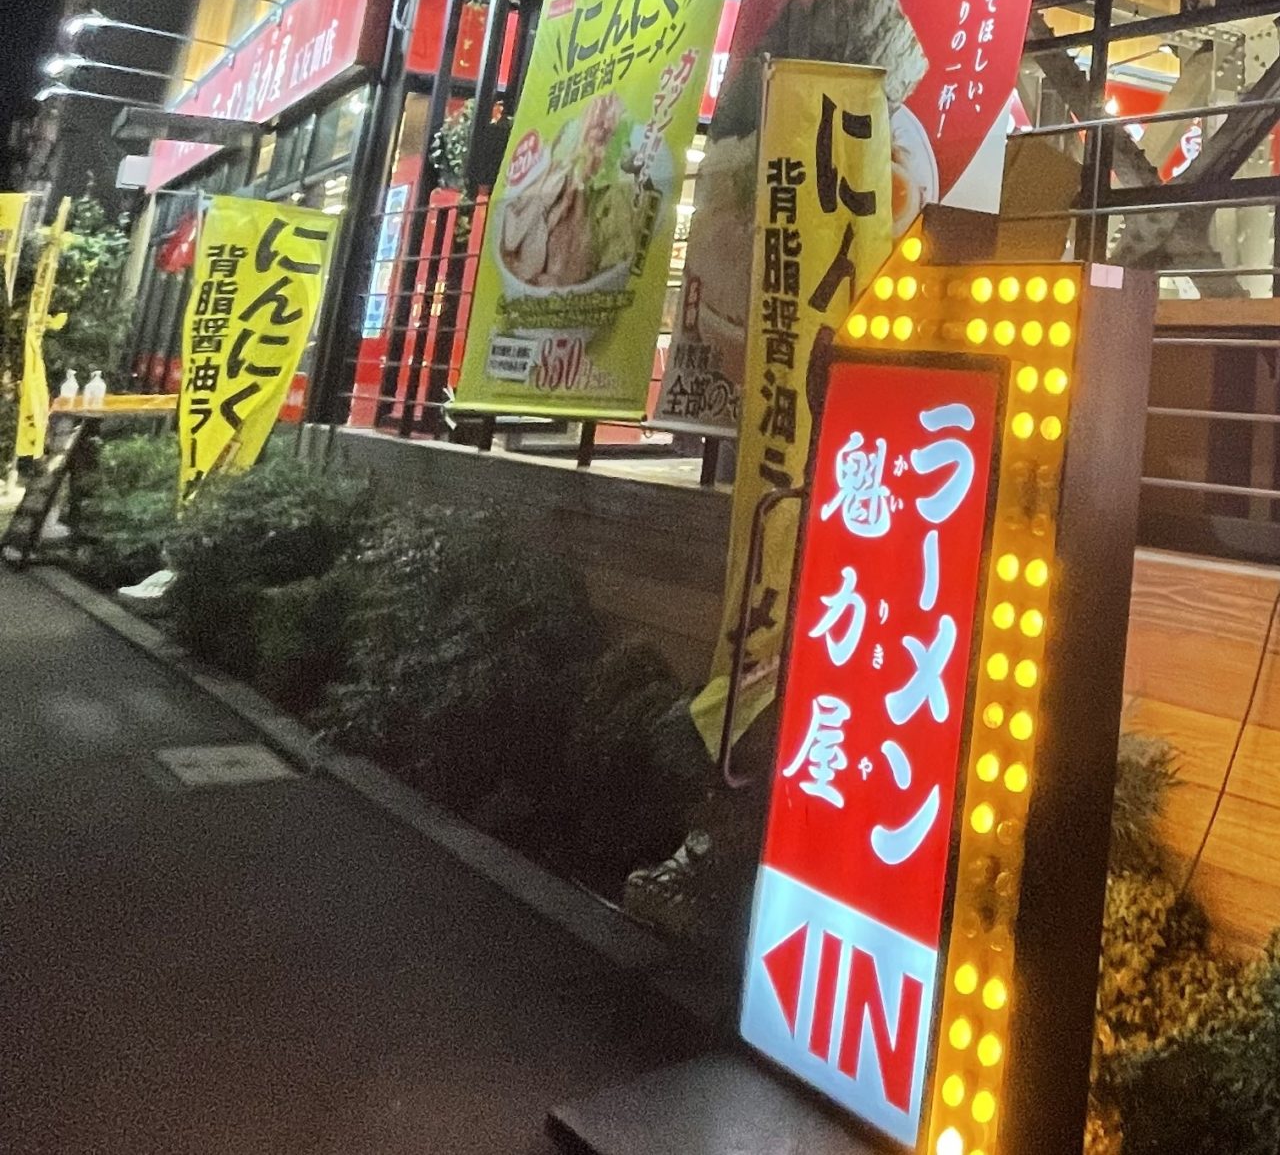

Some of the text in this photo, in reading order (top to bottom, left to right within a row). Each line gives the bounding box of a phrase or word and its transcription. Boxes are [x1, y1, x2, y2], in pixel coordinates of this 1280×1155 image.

[219, 217, 329, 433] にんにく
[783, 432, 890, 807] 魁力屋
[865, 404, 975, 865] ラーメン
[808, 929, 924, 1115] IN
